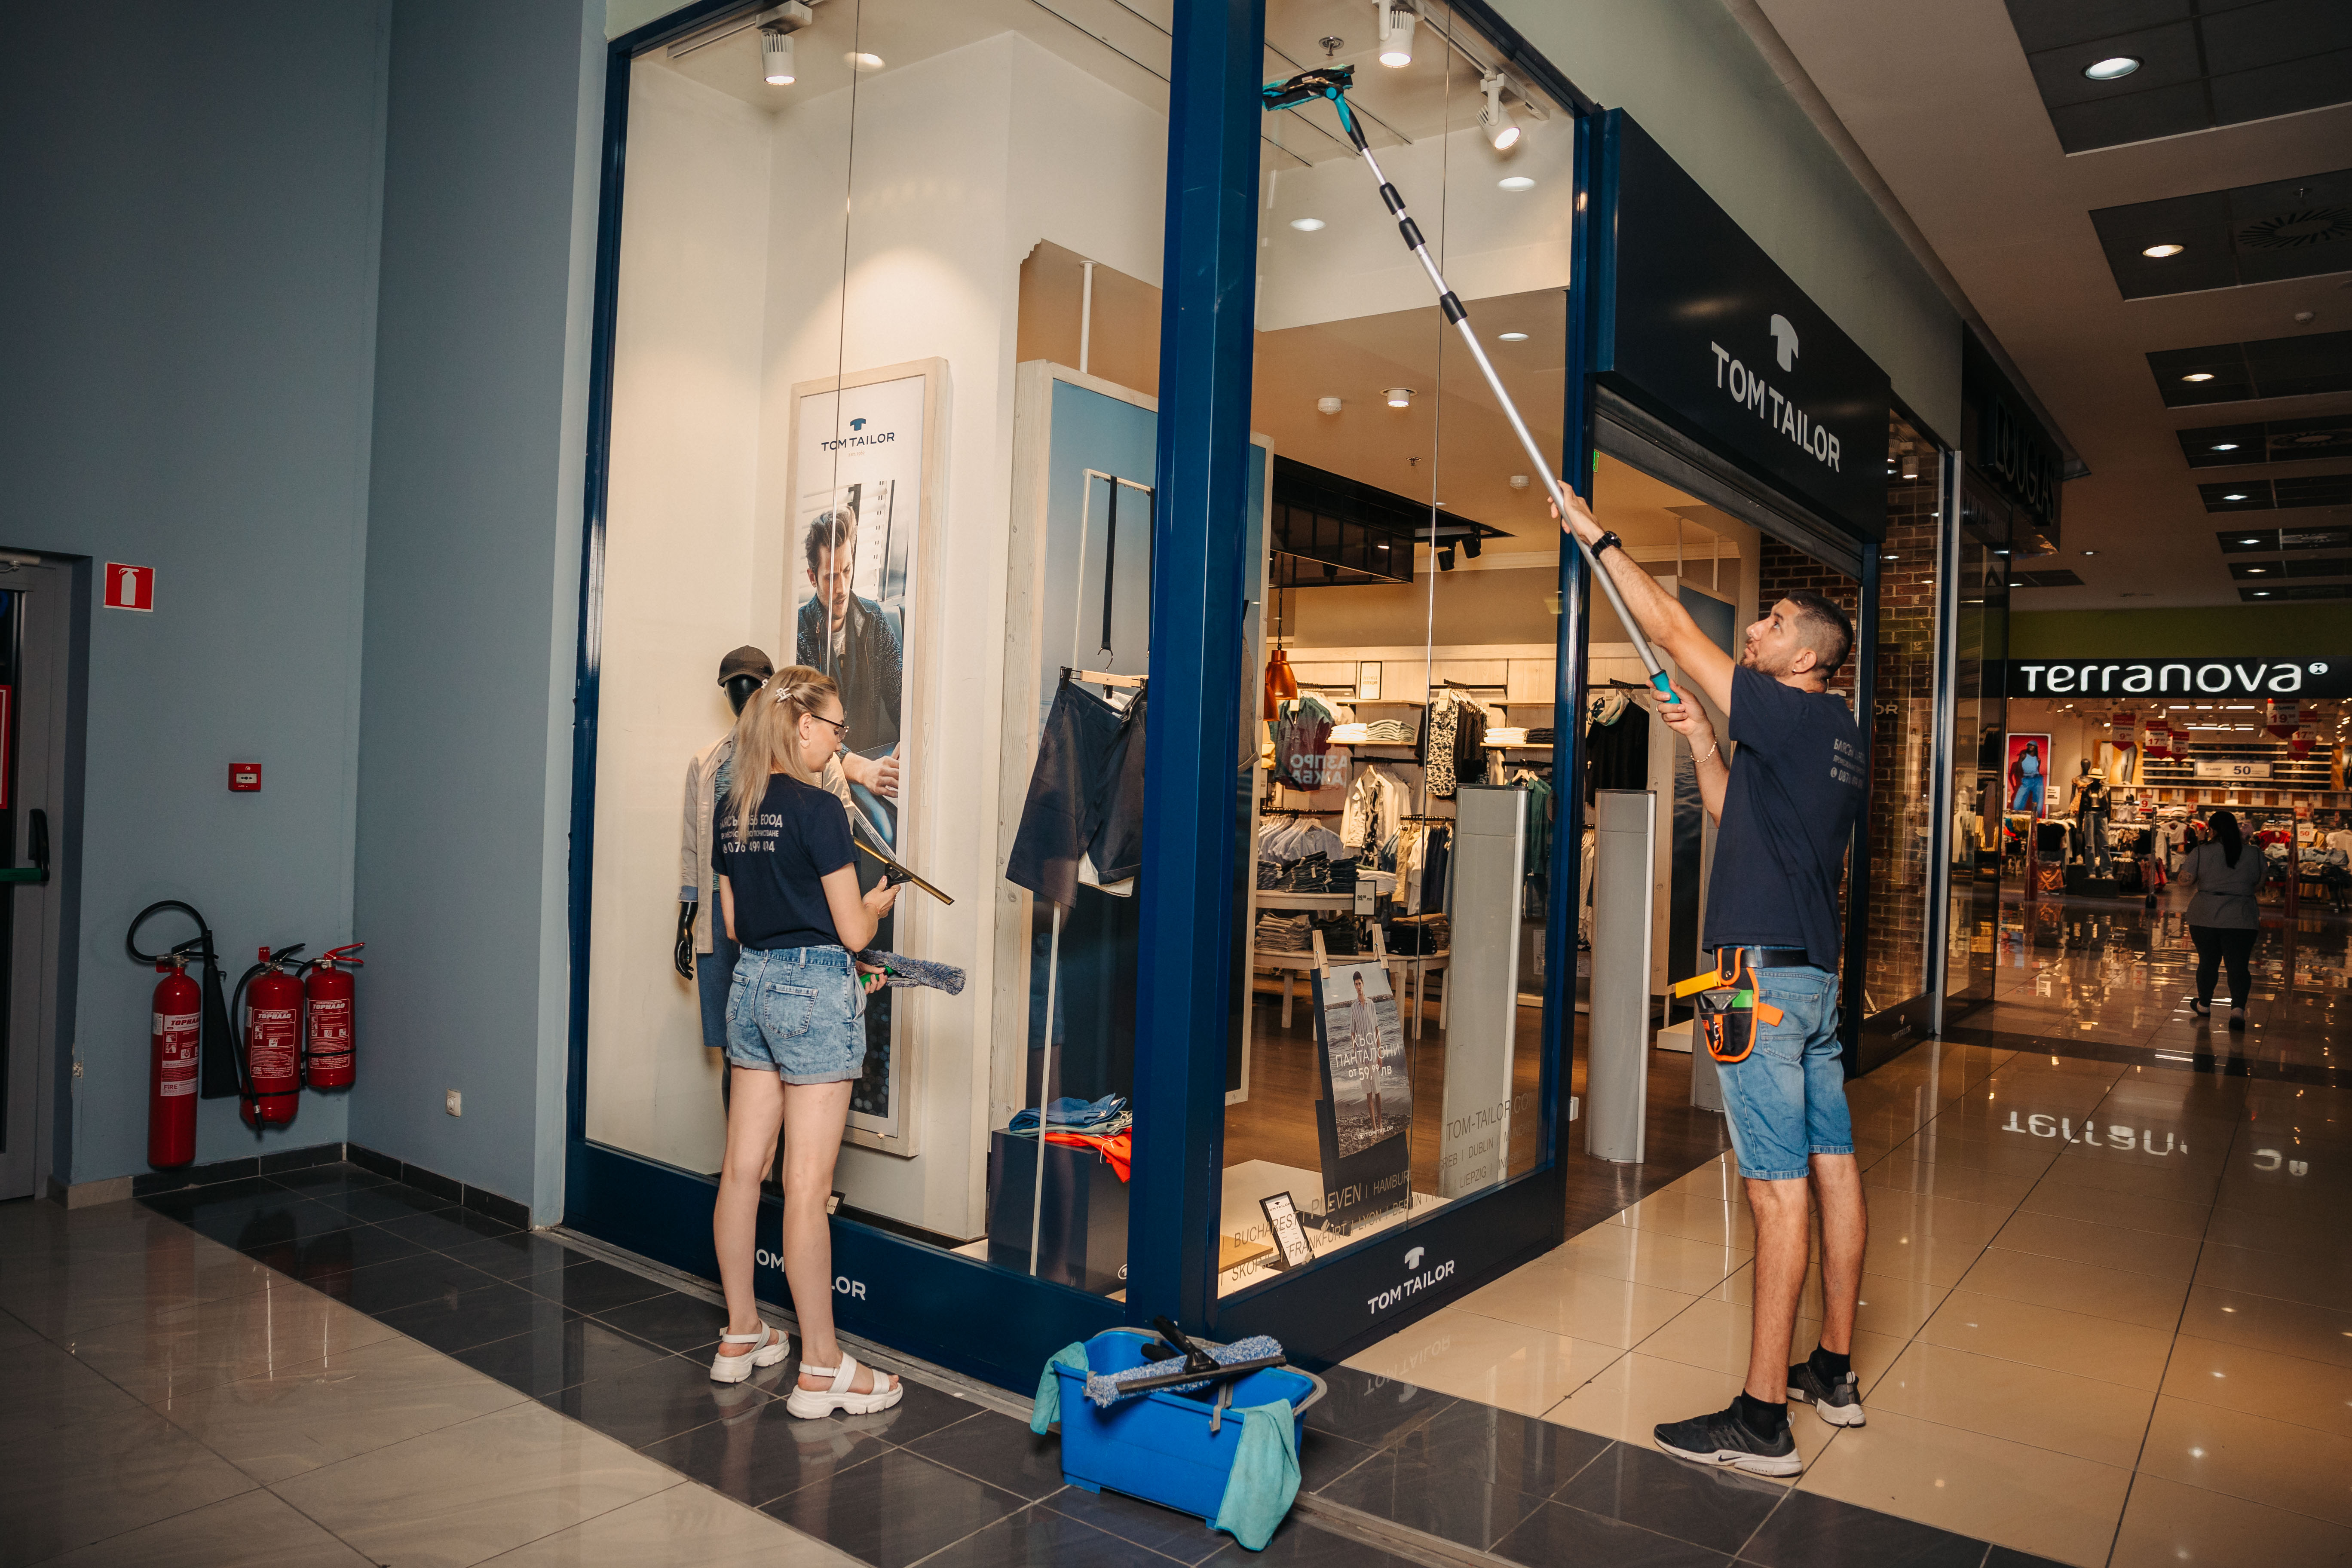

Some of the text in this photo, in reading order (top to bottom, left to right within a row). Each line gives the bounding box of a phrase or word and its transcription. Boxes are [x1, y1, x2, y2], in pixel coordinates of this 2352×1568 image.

[1712, 341, 1840, 472] TOM TAILOR
[821, 432, 895, 451] TOM TAILOR
[760, 814, 783, 828] ЕООД
[1352, 1031, 1381, 1048] КЪСИ
[1335, 1043, 1400, 1068] ПАНТАЛОНИ
[1376, 1125, 1393, 1135] TAILOR
[1234, 1210, 1300, 1248] BUCHAREST
[1311, 1182, 1361, 1219] PLEVEN
[1468, 1137, 1494, 1159] DUBLIN
[1232, 1251, 1274, 1281] SKOPJE
[1288, 1223, 1347, 1259] FRANKFURT
[1358, 1209, 1381, 1231] LYON
[1393, 1192, 1421, 1216] BERLIN
[1460, 1166, 1487, 1188] LIEPZIG
[1368, 1259, 1455, 1314] TOM TAILOR
